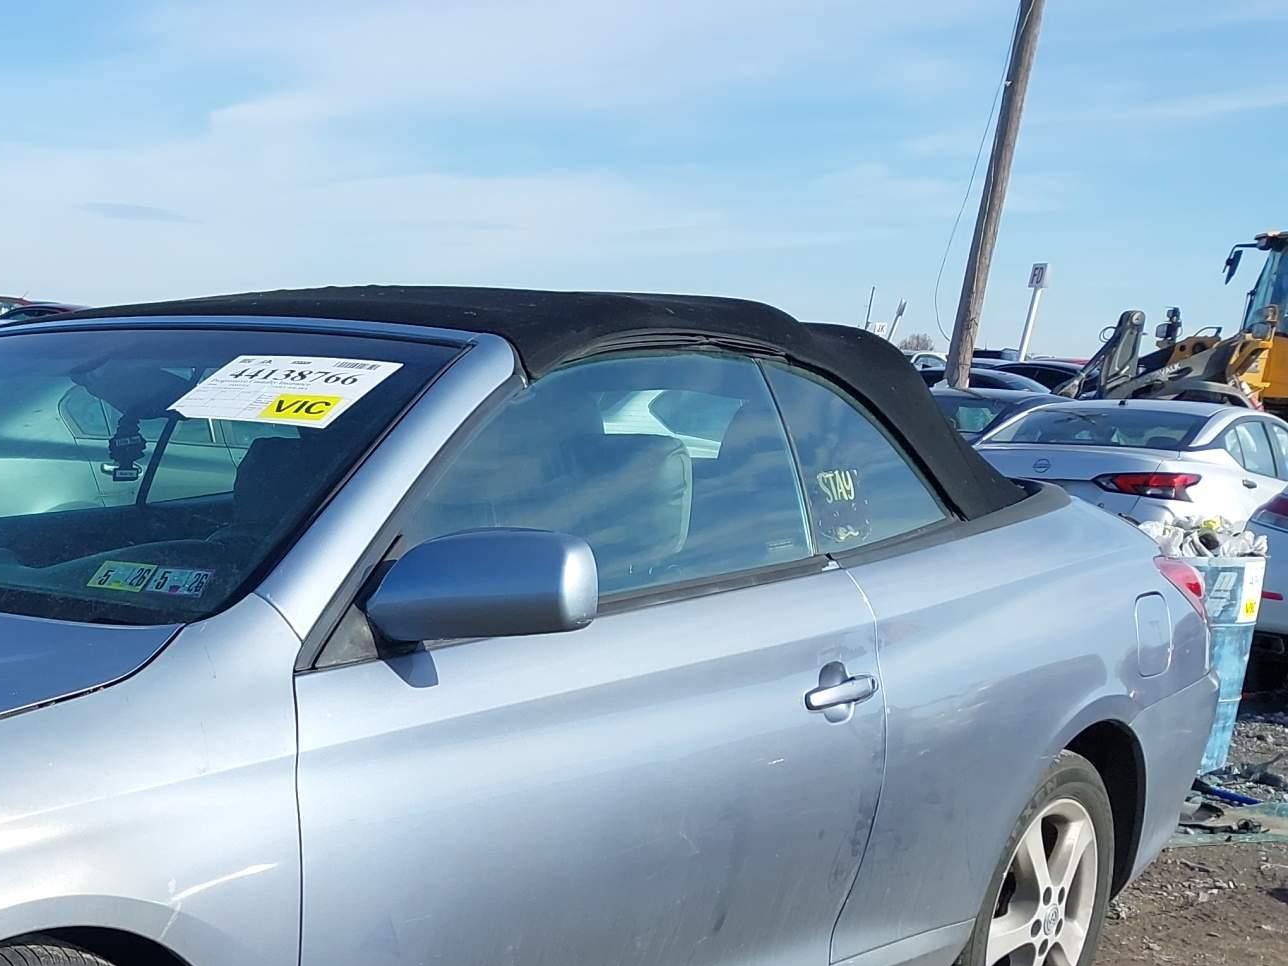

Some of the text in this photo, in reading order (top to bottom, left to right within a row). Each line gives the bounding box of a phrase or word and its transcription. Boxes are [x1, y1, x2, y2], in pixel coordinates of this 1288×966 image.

[229, 367, 359, 386] 44138766
[274, 399, 332, 415] VIC
[816, 469, 856, 504] STAY
